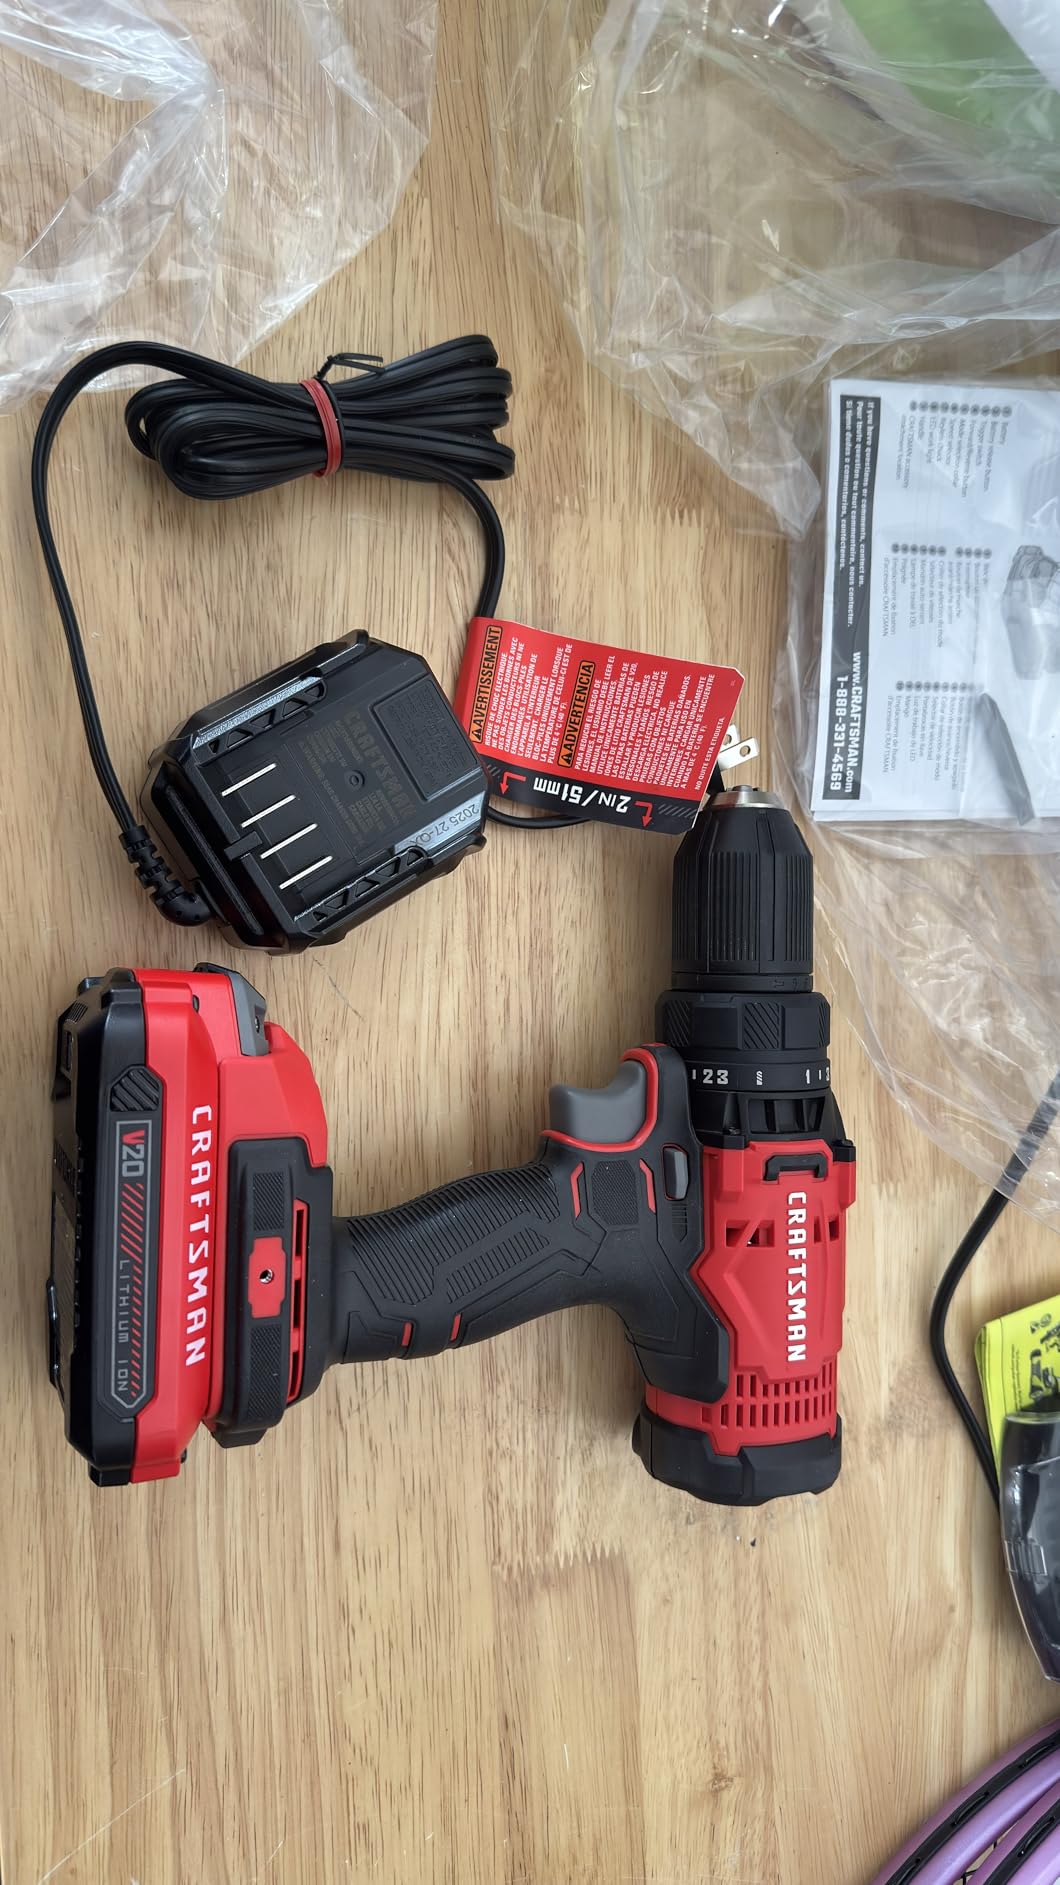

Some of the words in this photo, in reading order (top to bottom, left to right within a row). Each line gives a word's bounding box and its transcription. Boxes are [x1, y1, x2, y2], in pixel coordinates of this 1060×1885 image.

[845, 400, 852, 408] Si
[855, 401, 863, 419] Pour
[865, 409, 873, 424] you
[854, 421, 862, 441] toute
[864, 425, 872, 445] have
[843, 431, 851, 455] dudas
[852, 443, 861, 479] question
[862, 447, 871, 486] questions
[840, 464, 850, 517] comentarios,
[852, 480, 860, 490] ou
[862, 488, 869, 497] or
[851, 492, 859, 508] tout
[860, 499, 869, 542] comments,
[849, 510, 858, 564] commentaire,
[858, 543, 866, 573] contact
[848, 566, 856, 585] nous
[857, 575, 865, 587] us.
[846, 587, 855, 627] contacter.
[509, 636, 518, 655] AVEC
[517, 641, 525, 652] NE
[564, 643, 572, 653] DE
[515, 652, 523, 661] NI
[561, 653, 570, 666] EST
[607, 654, 615, 663] EL
[471, 627, 501, 728] AVERTISSEMENT
[503, 655, 514, 682] BORNES
[521, 663, 535, 704] UTILISATION
[530, 652, 538, 663] DE
[603, 663, 613, 680] LEER
[501, 683, 509, 696] LES
[505, 661, 521, 710] CONDUCTEURS
[512, 664, 527, 706] BLOCS-PILES
[555, 666, 567, 695] CELUI-CI
[593, 678, 601, 688] DE
[599, 680, 609, 698] DEBE
[626, 676, 634, 686] DE
[654, 670, 667, 697] REALICE
[490, 692, 500, 711] CHOC
[532, 722, 546, 760] BLOC-PILES
[540, 678, 556, 722] UNIQUEMENT
[550, 646, 563, 677] LORSQUE
[534, 684, 547, 716] CHARGER
[541, 675, 549, 684] LE
[552, 695, 560, 705] DE
[588, 688, 599, 713] RIESGO
[628, 681, 640, 708] PUEDEN
[651, 698, 660, 708] NO
[697, 673, 715, 712] ENCUENTRE
[495, 696, 506, 723] SONDER
[509, 707, 518, 721] DES
[562, 662, 593, 752] ADVERTENCIA
[592, 699, 604, 728] USUARIO
[616, 686, 631, 727] CRAFTSMAN
[662, 700, 676, 727] CARGUE
[683, 699, 691, 709] EN
[488, 712, 496, 721] DE
[500, 710, 511, 736] OBJETS
[585, 713, 593, 722] EL
[596, 749, 608, 774] UTILICE
[621, 662, 629, 671] DE
[618, 747, 632, 779] ESTALLAR
[628, 706, 642, 741] PRODUCIR
[636, 674, 650, 706] LESIONES
[625, 738, 641, 780] PERSONALES
[645, 680, 657, 705] RIESGO
[651, 670, 659, 680] DE
[652, 706, 666, 736] OBJETOS
[678, 709, 688, 724] USO
[694, 712, 702, 722] SE
[844, 651, 863, 792] www.CRAFTSMAN.com
[484, 721, 494, 746] RISQUE
[492, 724, 500, 738] PAS
[503, 721, 515, 752] CHARGER
[517, 720, 530, 756] L'APPAREIL
[551, 736, 559, 745] DE
[579, 723, 591, 751] REDUCIR
[590, 729, 597, 737] EL
[611, 728, 621, 745] LITIO
[660, 727, 668, 736] NI
[673, 724, 684, 742] PARA
[678, 719, 692, 747] CARGAR
[829, 674, 848, 790] 1-888-331-4569
[490, 738, 498, 748] NE
[497, 736, 505, 750] DES
[589, 743, 601, 773] MANUAL
[596, 734, 604, 743] DE
[609, 745, 617, 755] DE
[614, 742, 625, 764] OTRAS
[648, 737, 657, 752] CON
[704, 745, 714, 761] ESTA
[539, 752, 547, 762] LA
[547, 746, 557, 763] PLUS
[574, 751, 584, 769] PARA
[632, 746, 647, 781] DESCARGA
[646, 736, 665, 784] CONDUCTORES
[652, 751, 668, 784] PAQUETES
[662, 741, 671, 751] DE
[682, 750, 690, 759] LA
[687, 757, 696, 766] DE
[604, 755, 614, 776] IONES
[611, 764, 619, 777] LAS
[639, 752, 653, 783] PRUEBAS
[673, 760, 687, 788] CUANDO
[697, 761, 709, 780] QUITE
[694, 780, 702, 790] NO
[447, 803, 480, 827] 2025
[806, 1069, 811, 1084] 1
[121, 1130, 145, 1178] V20
[185, 1104, 212, 1366] CRAFTSMAN
[787, 1191, 807, 1362] CRAFTSMAN
[118, 1261, 130, 1343] LITHIUM
[118, 1361, 129, 1393] ION
